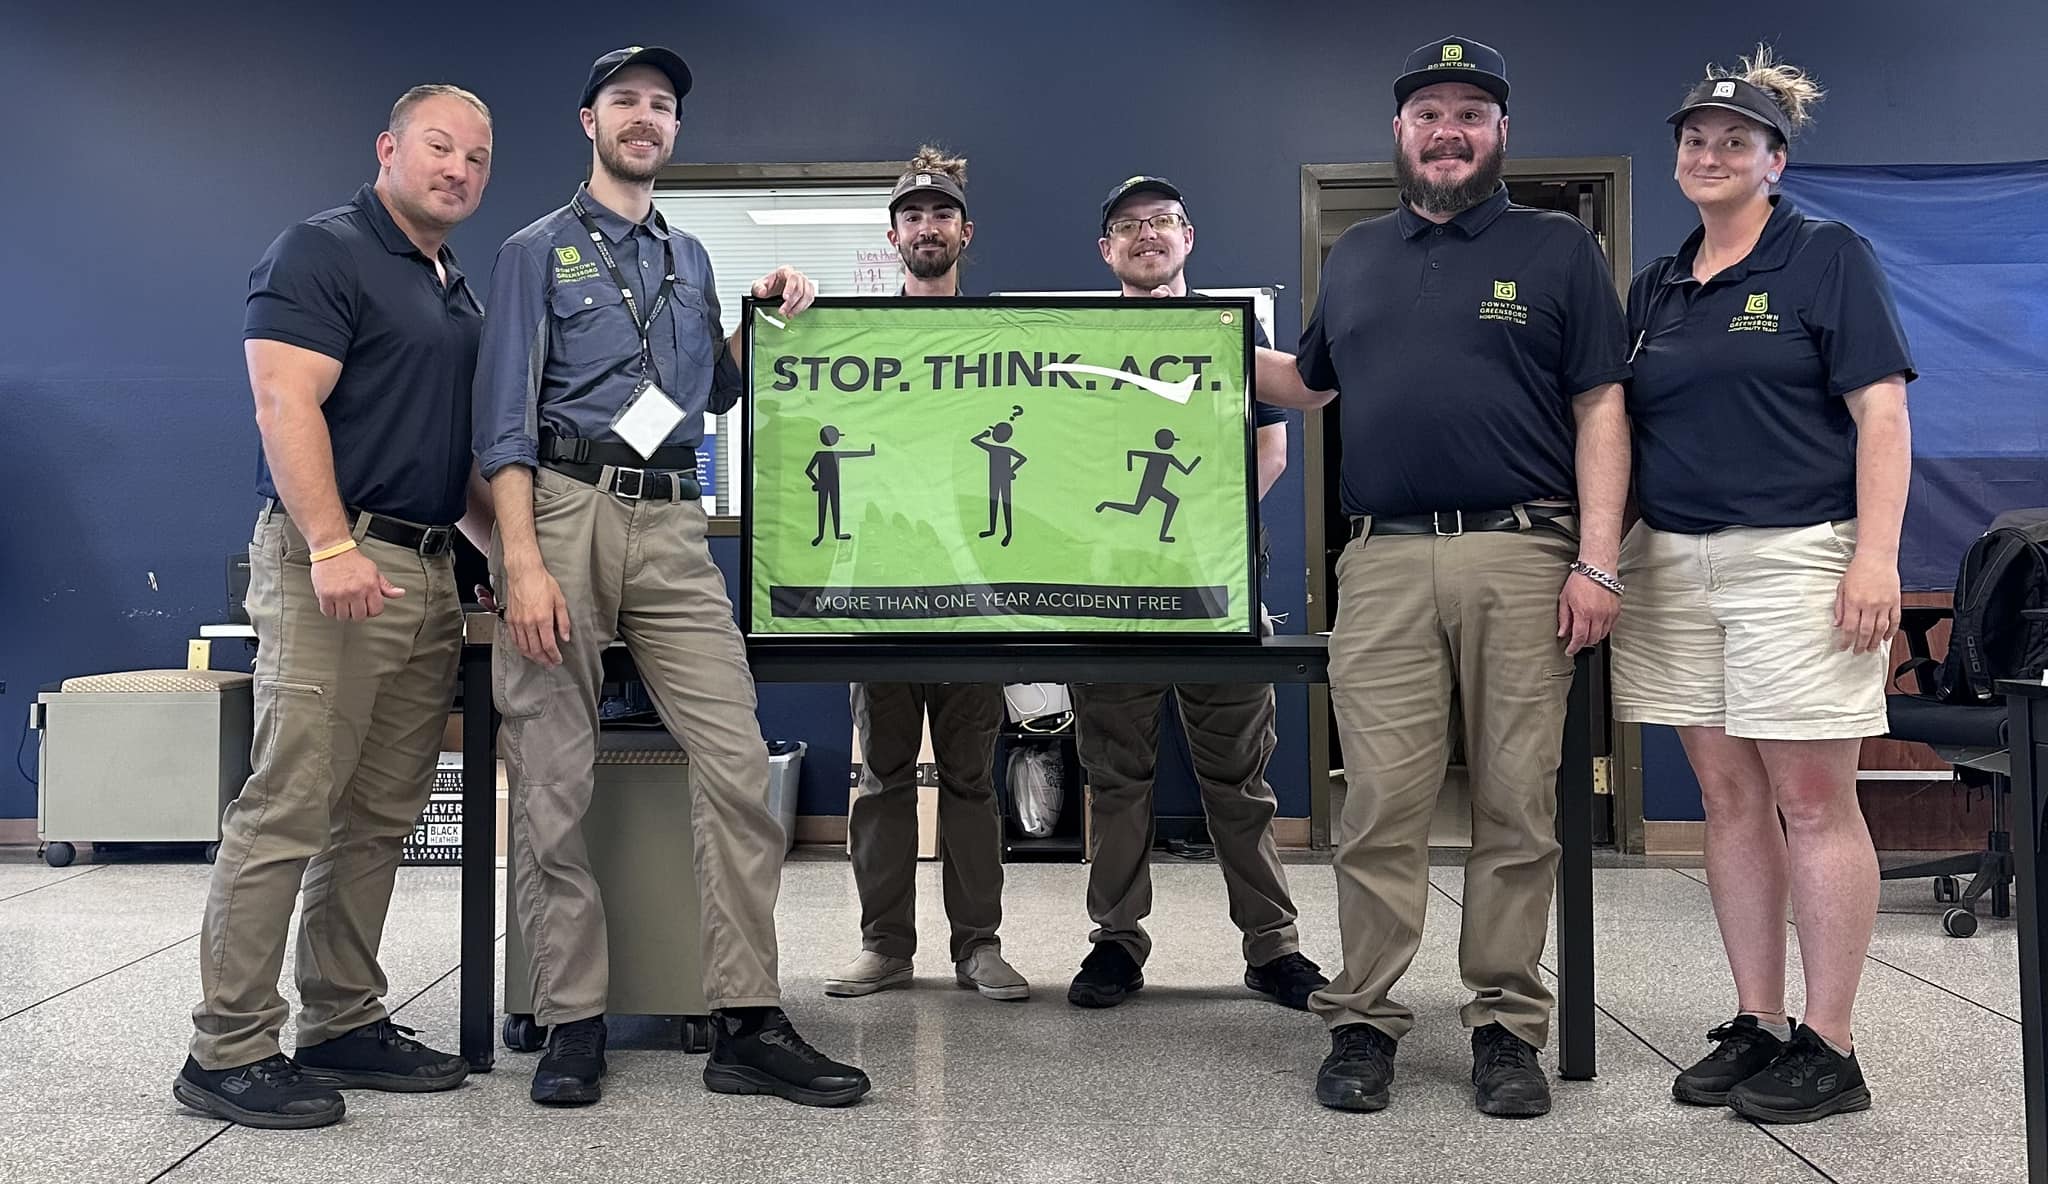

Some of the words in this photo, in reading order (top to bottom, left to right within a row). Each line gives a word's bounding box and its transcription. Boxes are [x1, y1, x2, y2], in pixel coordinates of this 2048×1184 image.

[1427, 61, 1476, 70] DOWNTOWN
[1481, 301, 1528, 312] DOWNTOWN
[1480, 308, 1528, 319] GREENSBORO
[1732, 314, 1779, 323] DOWNTOWN
[1729, 320, 1779, 328] GREENSBORO
[772, 355, 911, 392] STOP.
[924, 351, 1097, 391] THINK.
[1111, 355, 1222, 391] ACT.
[815, 595, 870, 611] MORE
[875, 595, 931, 610] THAN
[934, 593, 976, 609] ONE
[981, 592, 1030, 607] YEAR
[1035, 592, 1132, 609] ACCIDENT
[1137, 596, 1183, 611] FREE
[422, 814, 463, 822] TUBULAR
[430, 825, 459, 836] BLACK
[430, 836, 460, 844] HEATHER
